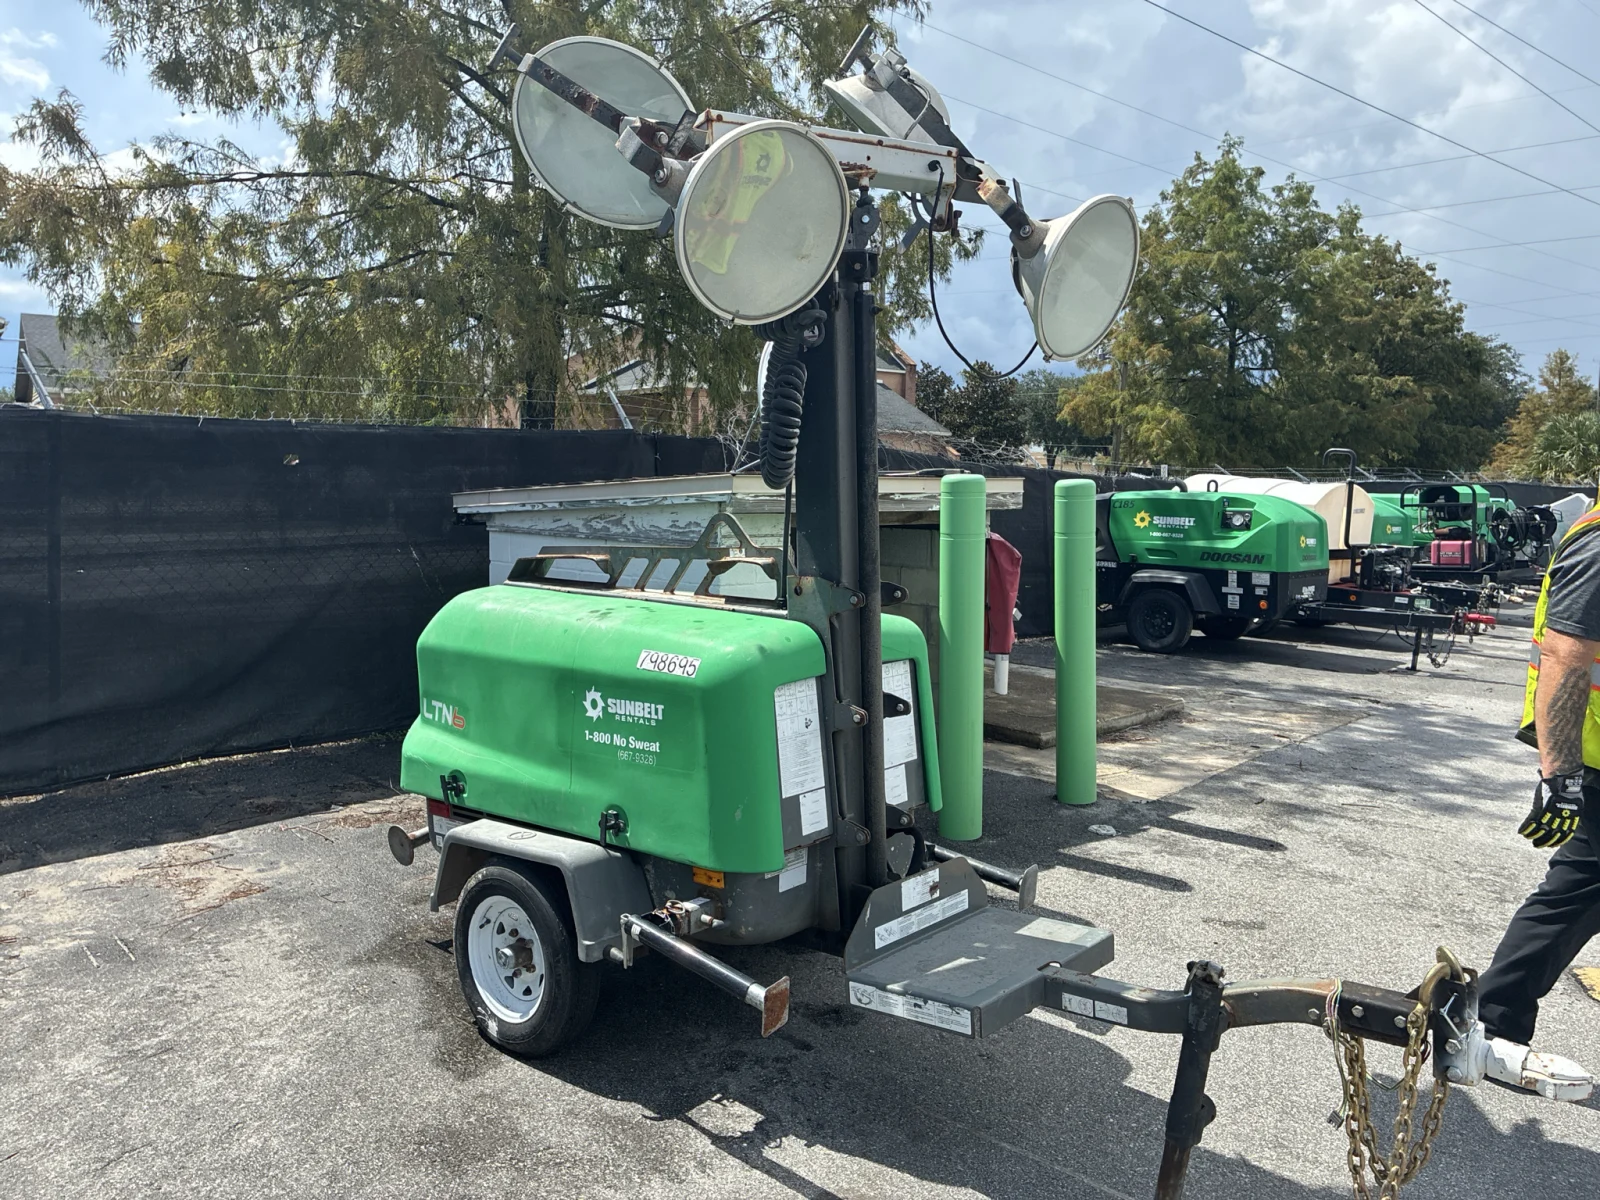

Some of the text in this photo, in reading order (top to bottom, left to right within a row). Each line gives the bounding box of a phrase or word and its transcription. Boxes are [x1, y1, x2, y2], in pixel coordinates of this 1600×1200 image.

[1113, 500, 1135, 509] C185
[1152, 515, 1195, 526] SUNBELT
[1200, 551, 1265, 565] DOOSAN
[640, 650, 700, 677] 798695
[607, 698, 664, 720] SUNBELT
[615, 714, 656, 726] RENTALS
[584, 730, 661, 753] 1-800 No Sweat
[617, 749, 657, 767] (667-9328)
